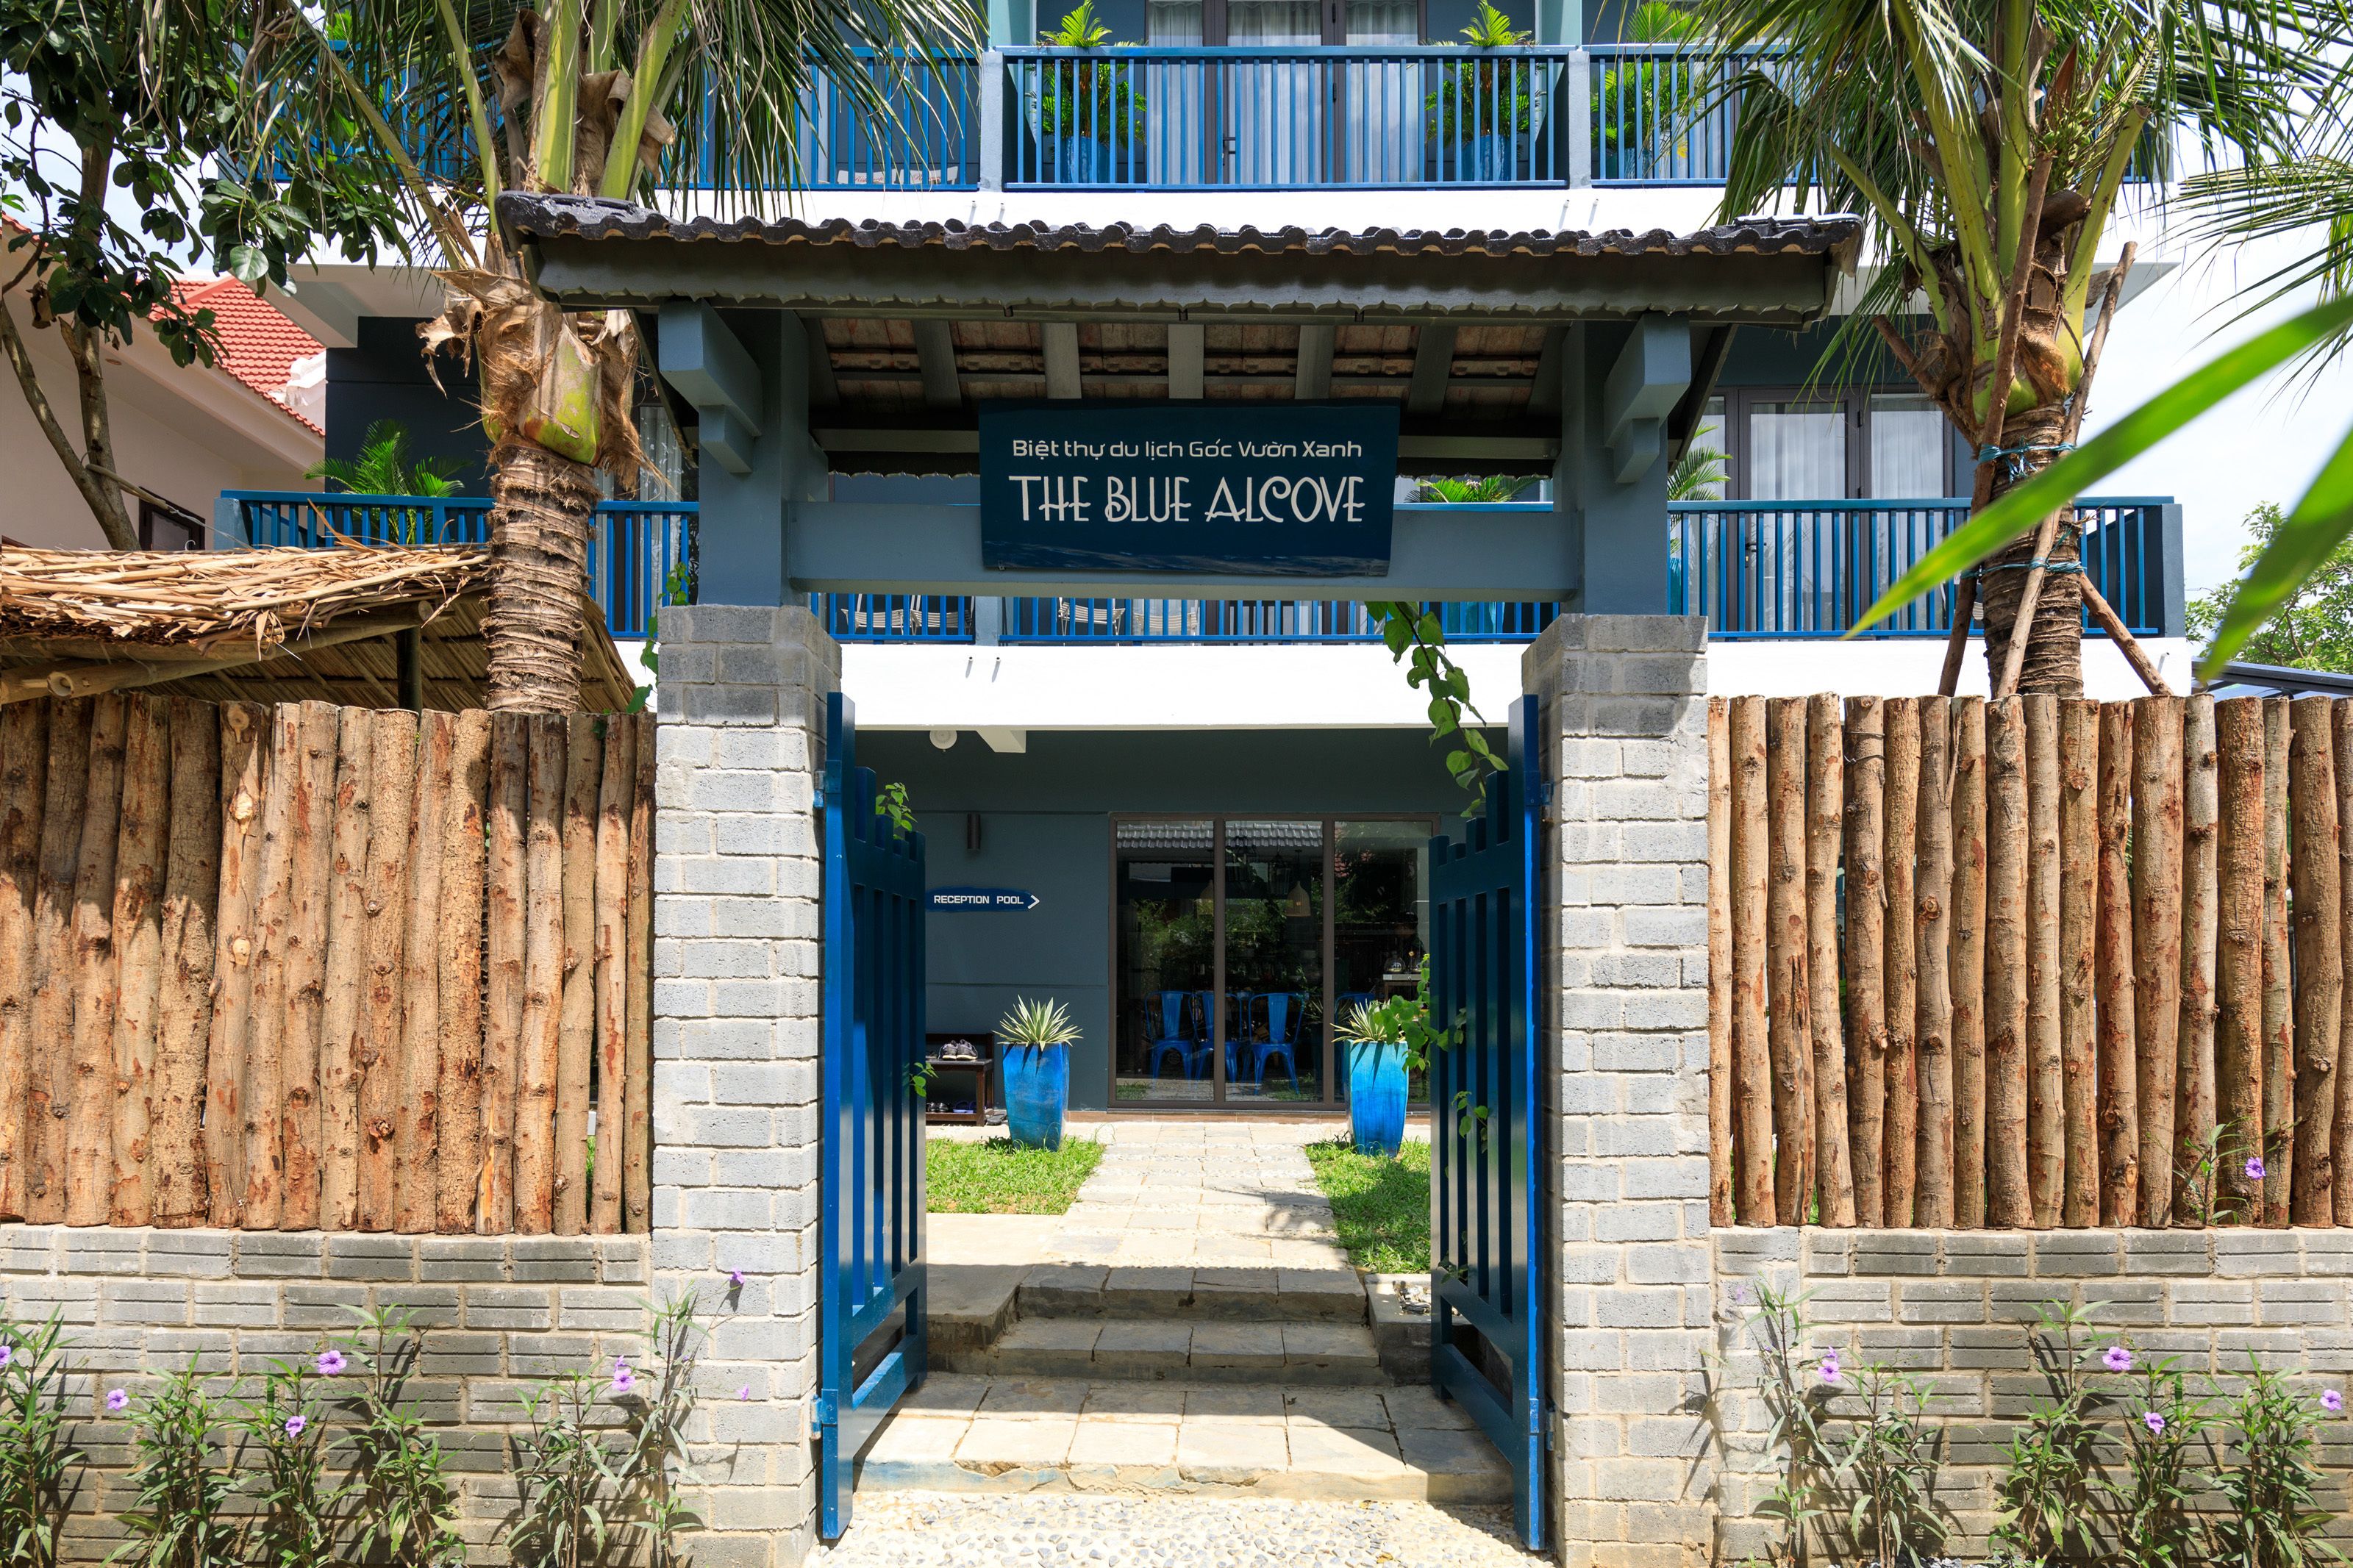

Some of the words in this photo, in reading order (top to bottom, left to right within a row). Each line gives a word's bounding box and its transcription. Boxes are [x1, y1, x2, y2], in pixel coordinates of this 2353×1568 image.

[1013, 440, 1060, 460] Biệt
[1064, 440, 1106, 461] thự
[1110, 440, 1139, 457] du
[1146, 440, 1183, 461] lịch
[1189, 438, 1232, 457] Góc
[1238, 441, 1296, 457] Vườn
[1302, 440, 1362, 457] Xanh
[1008, 475, 1091, 522] THE
[1104, 476, 1192, 523] BLUE
[1204, 476, 1365, 523] ALCOVE
[934, 895, 990, 904] RECEPTION
[996, 895, 1024, 904] POOL
